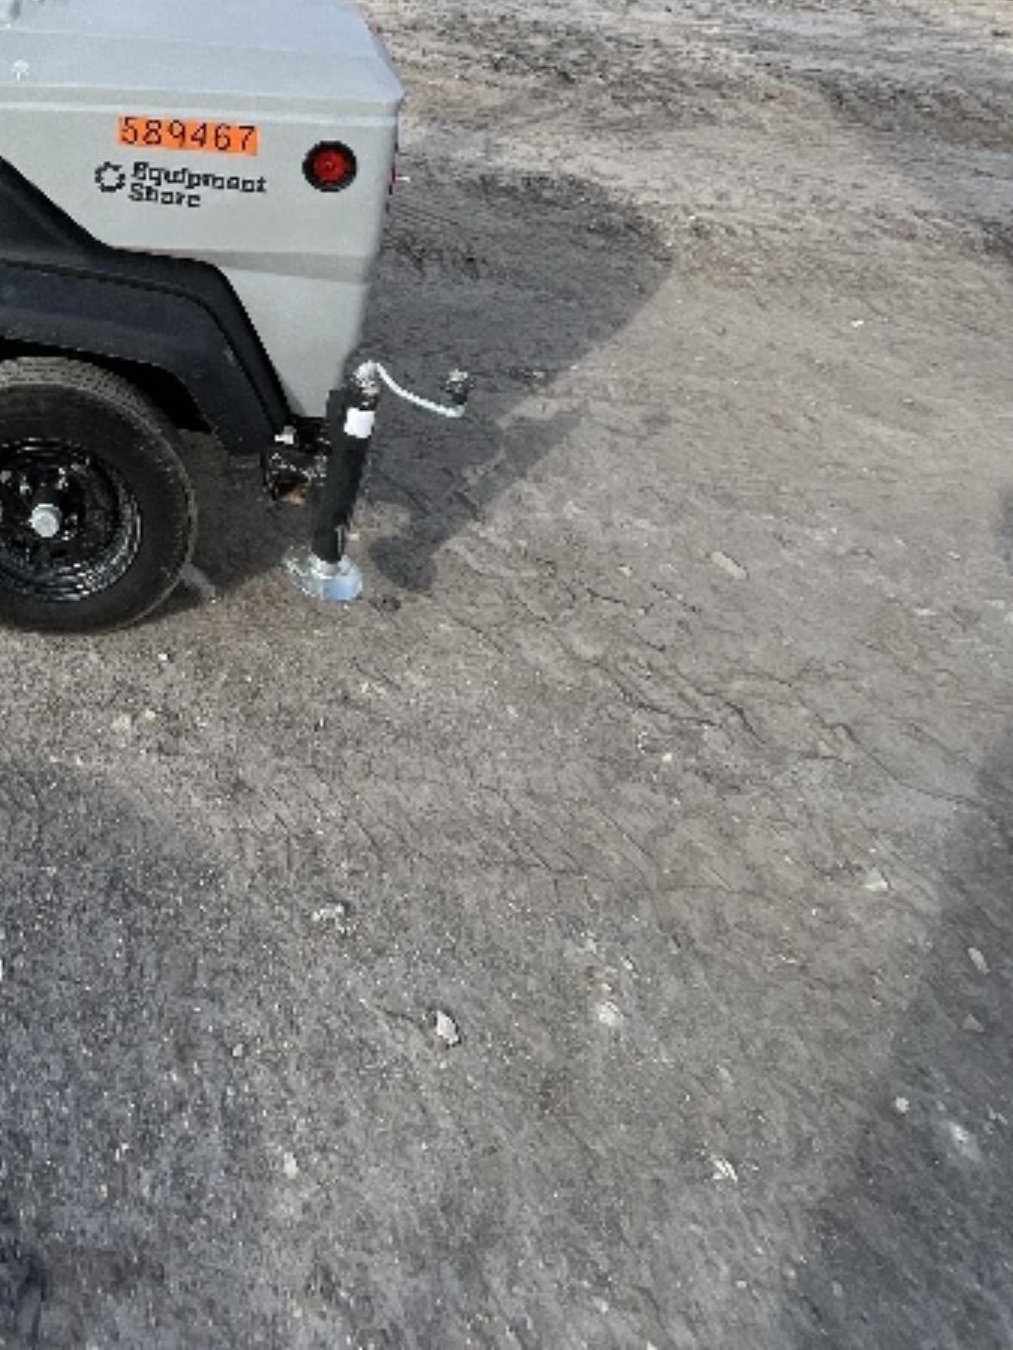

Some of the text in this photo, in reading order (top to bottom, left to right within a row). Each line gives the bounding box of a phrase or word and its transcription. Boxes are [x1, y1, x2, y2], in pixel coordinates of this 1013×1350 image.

[120, 116, 256, 151] 589467
[131, 161, 267, 193] Equipment
[128, 182, 201, 208] Share
